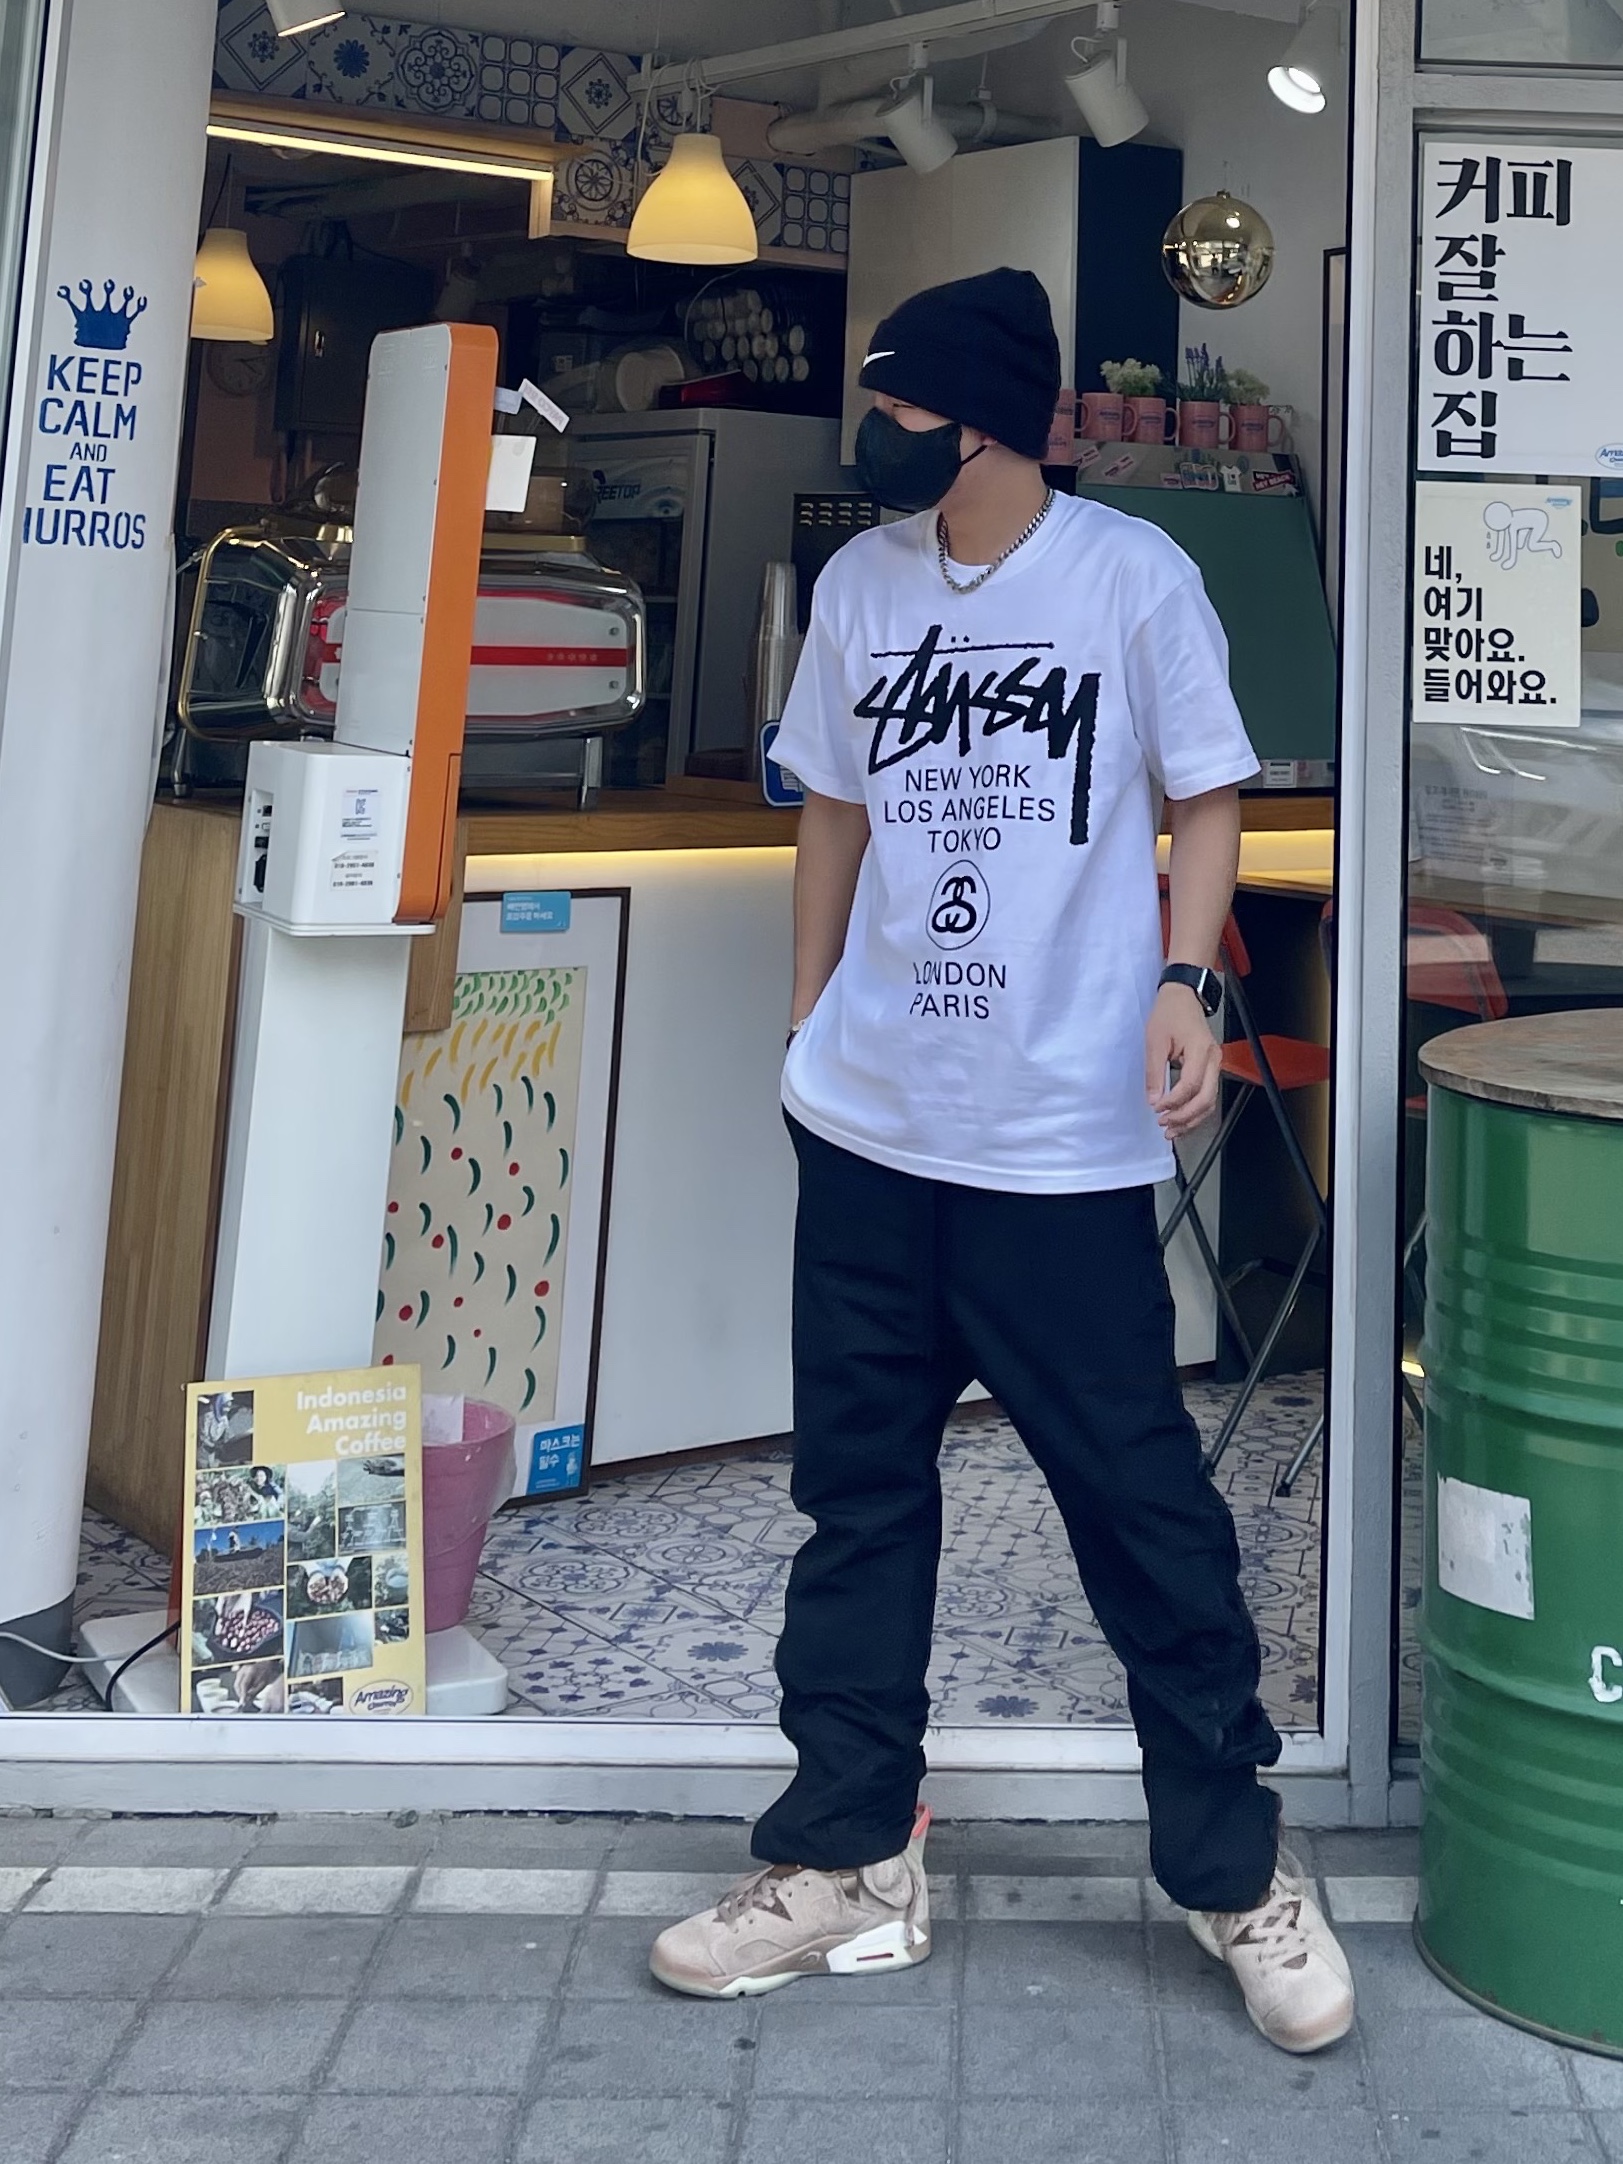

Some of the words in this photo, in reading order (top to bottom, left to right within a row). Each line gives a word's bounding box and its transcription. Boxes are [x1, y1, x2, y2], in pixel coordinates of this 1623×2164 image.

[1435, 156, 1573, 226] 커피
[1434, 233, 1506, 302] 잘
[1431, 309, 1573, 381] 하는
[46, 354, 143, 397] KEEP
[38, 397, 137, 440] CALM
[1430, 390, 1498, 459] 집
[69, 442, 107, 462] AND
[43, 464, 116, 504] EAT
[1424, 546, 1462, 583] 네,
[1424, 586, 1482, 621] 여기
[1424, 627, 1525, 662] 맞아요.
[1423, 668, 1557, 704] 들어와요.
[905, 766, 962, 792] NEW
[969, 764, 1031, 789] YORK
[884, 800, 933, 823] LOS
[941, 795, 1055, 822] ANGELES
[927, 826, 1001, 853] TOKYO
[913, 961, 1006, 989] LONDON
[909, 992, 990, 1020] PARIS
[296, 1381, 407, 1411] Indonesia
[306, 1408, 407, 1434] Amazing
[335, 1430, 406, 1456] Coffee
